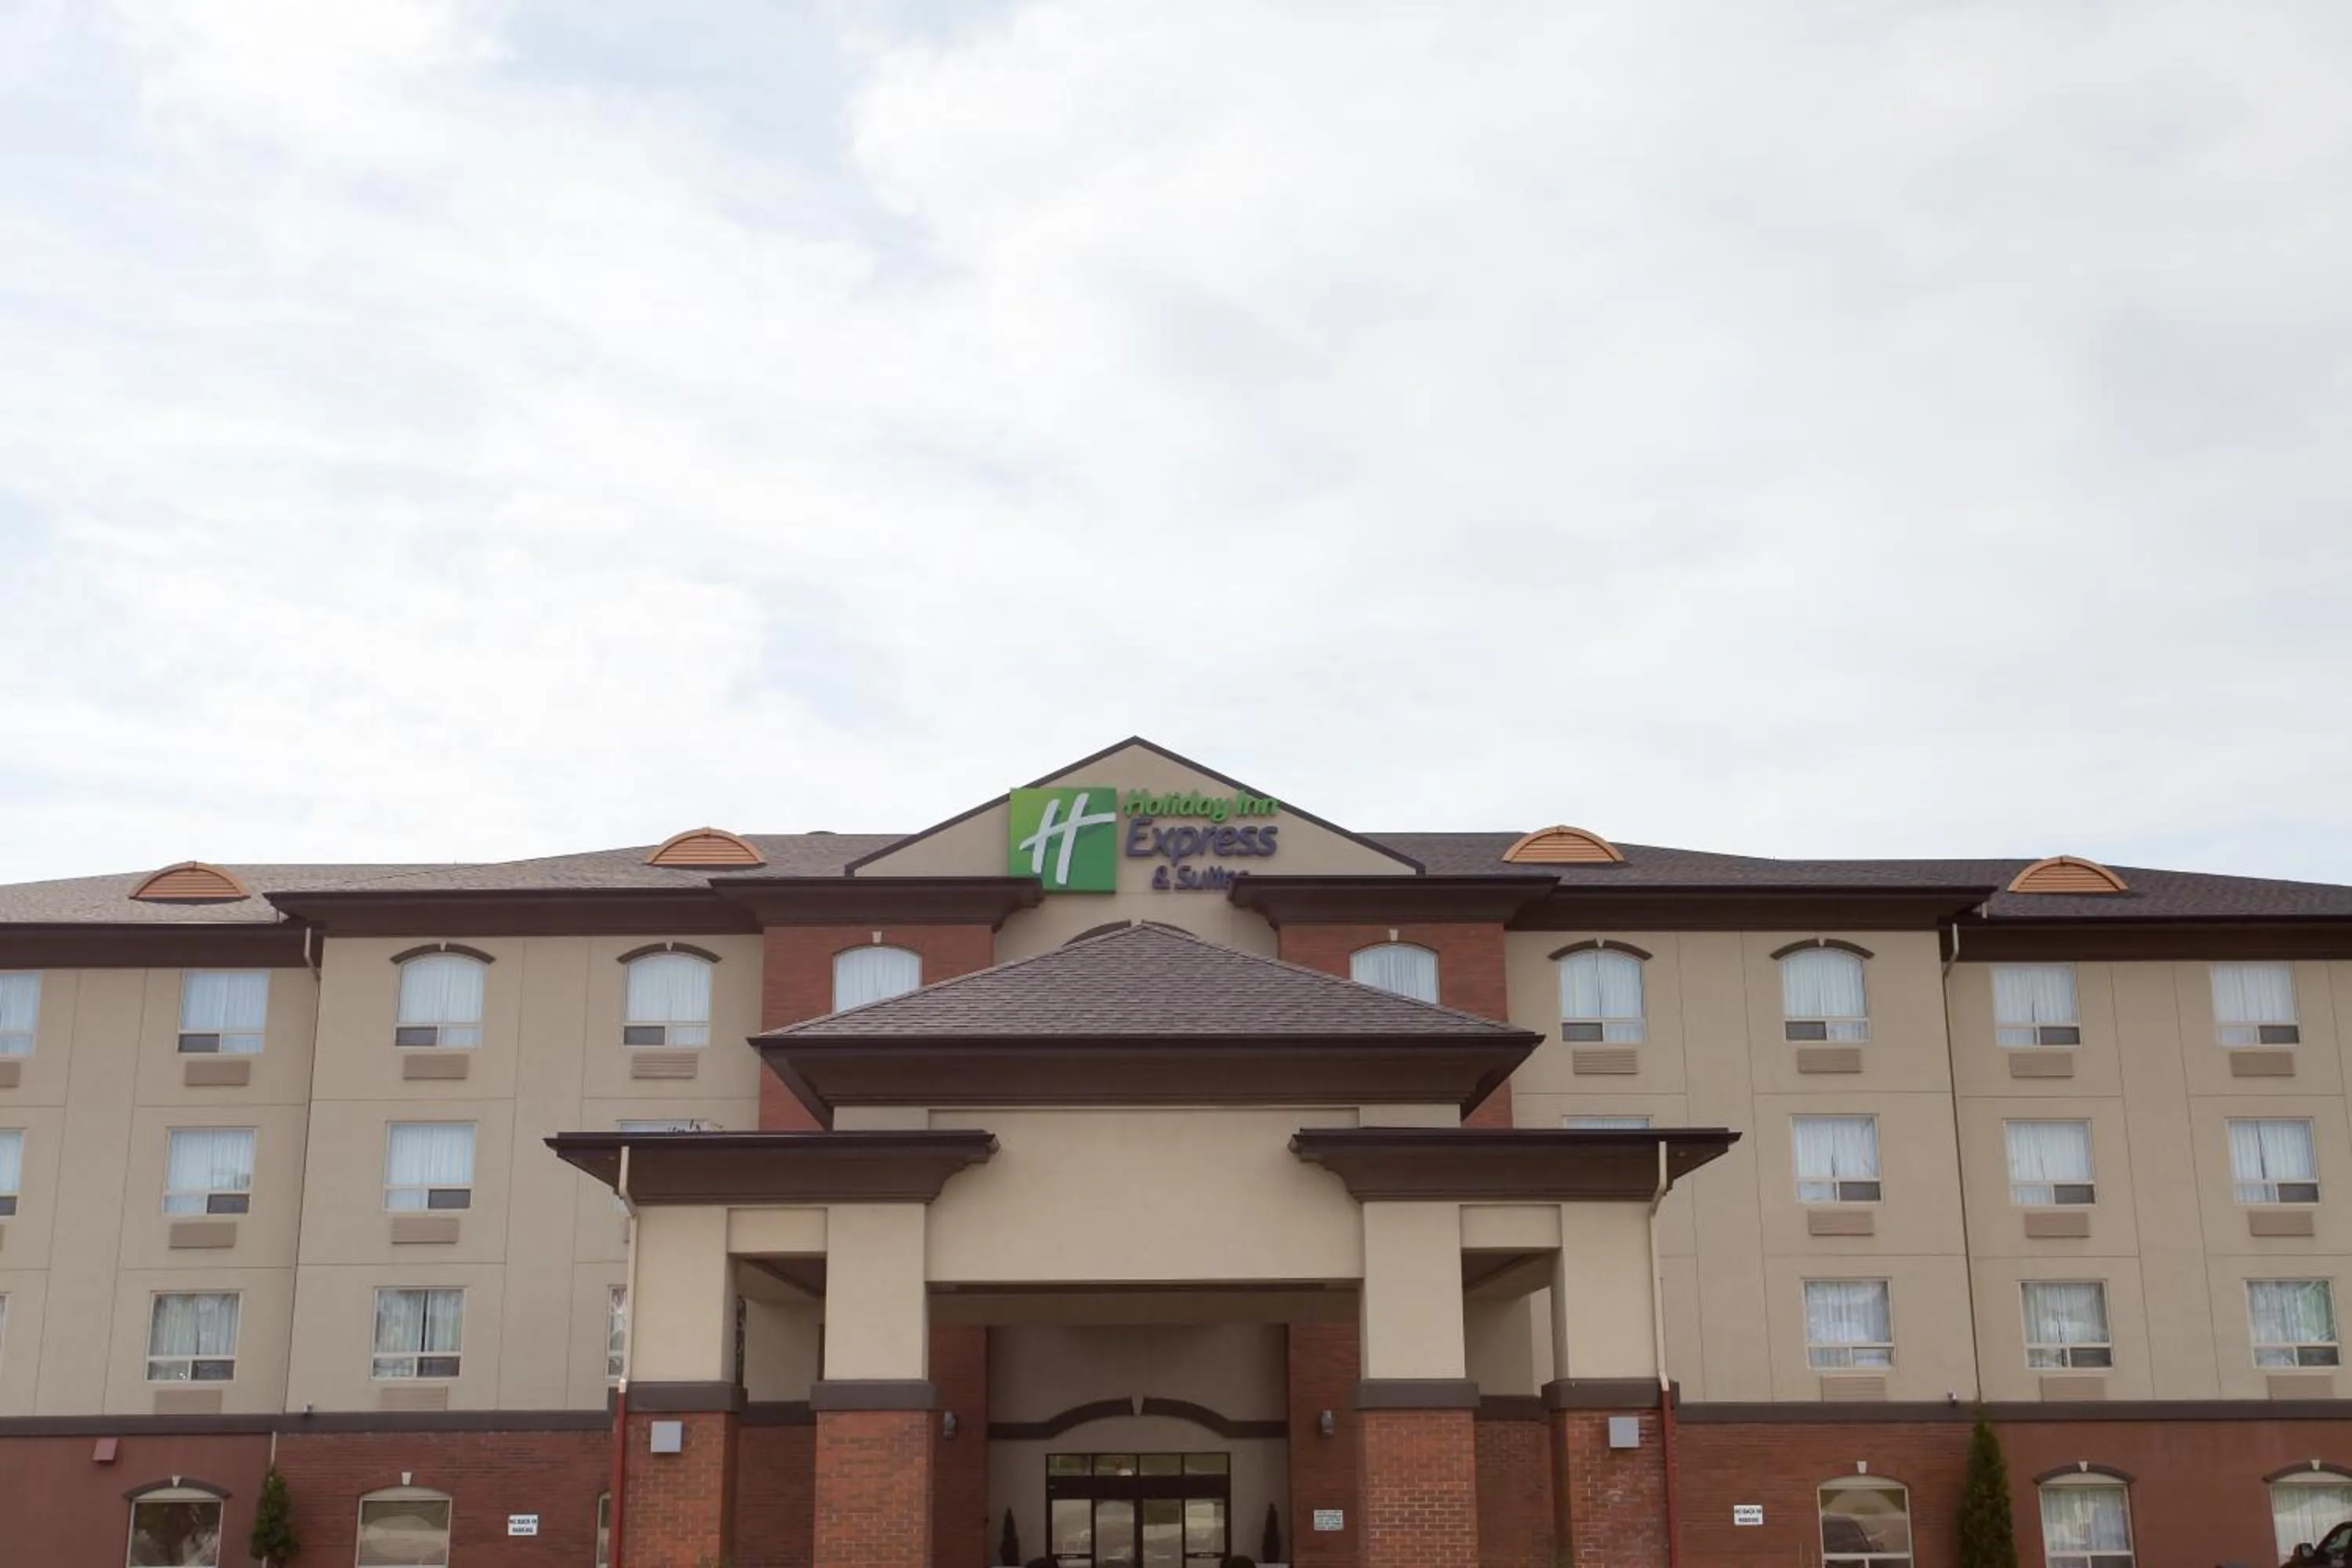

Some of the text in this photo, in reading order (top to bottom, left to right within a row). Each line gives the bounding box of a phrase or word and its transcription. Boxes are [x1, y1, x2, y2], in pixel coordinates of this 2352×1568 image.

[1124, 789, 1279, 822] Holiday Inn
[1127, 815, 1279, 866] Express
[1152, 865, 1250, 891] & Suite
